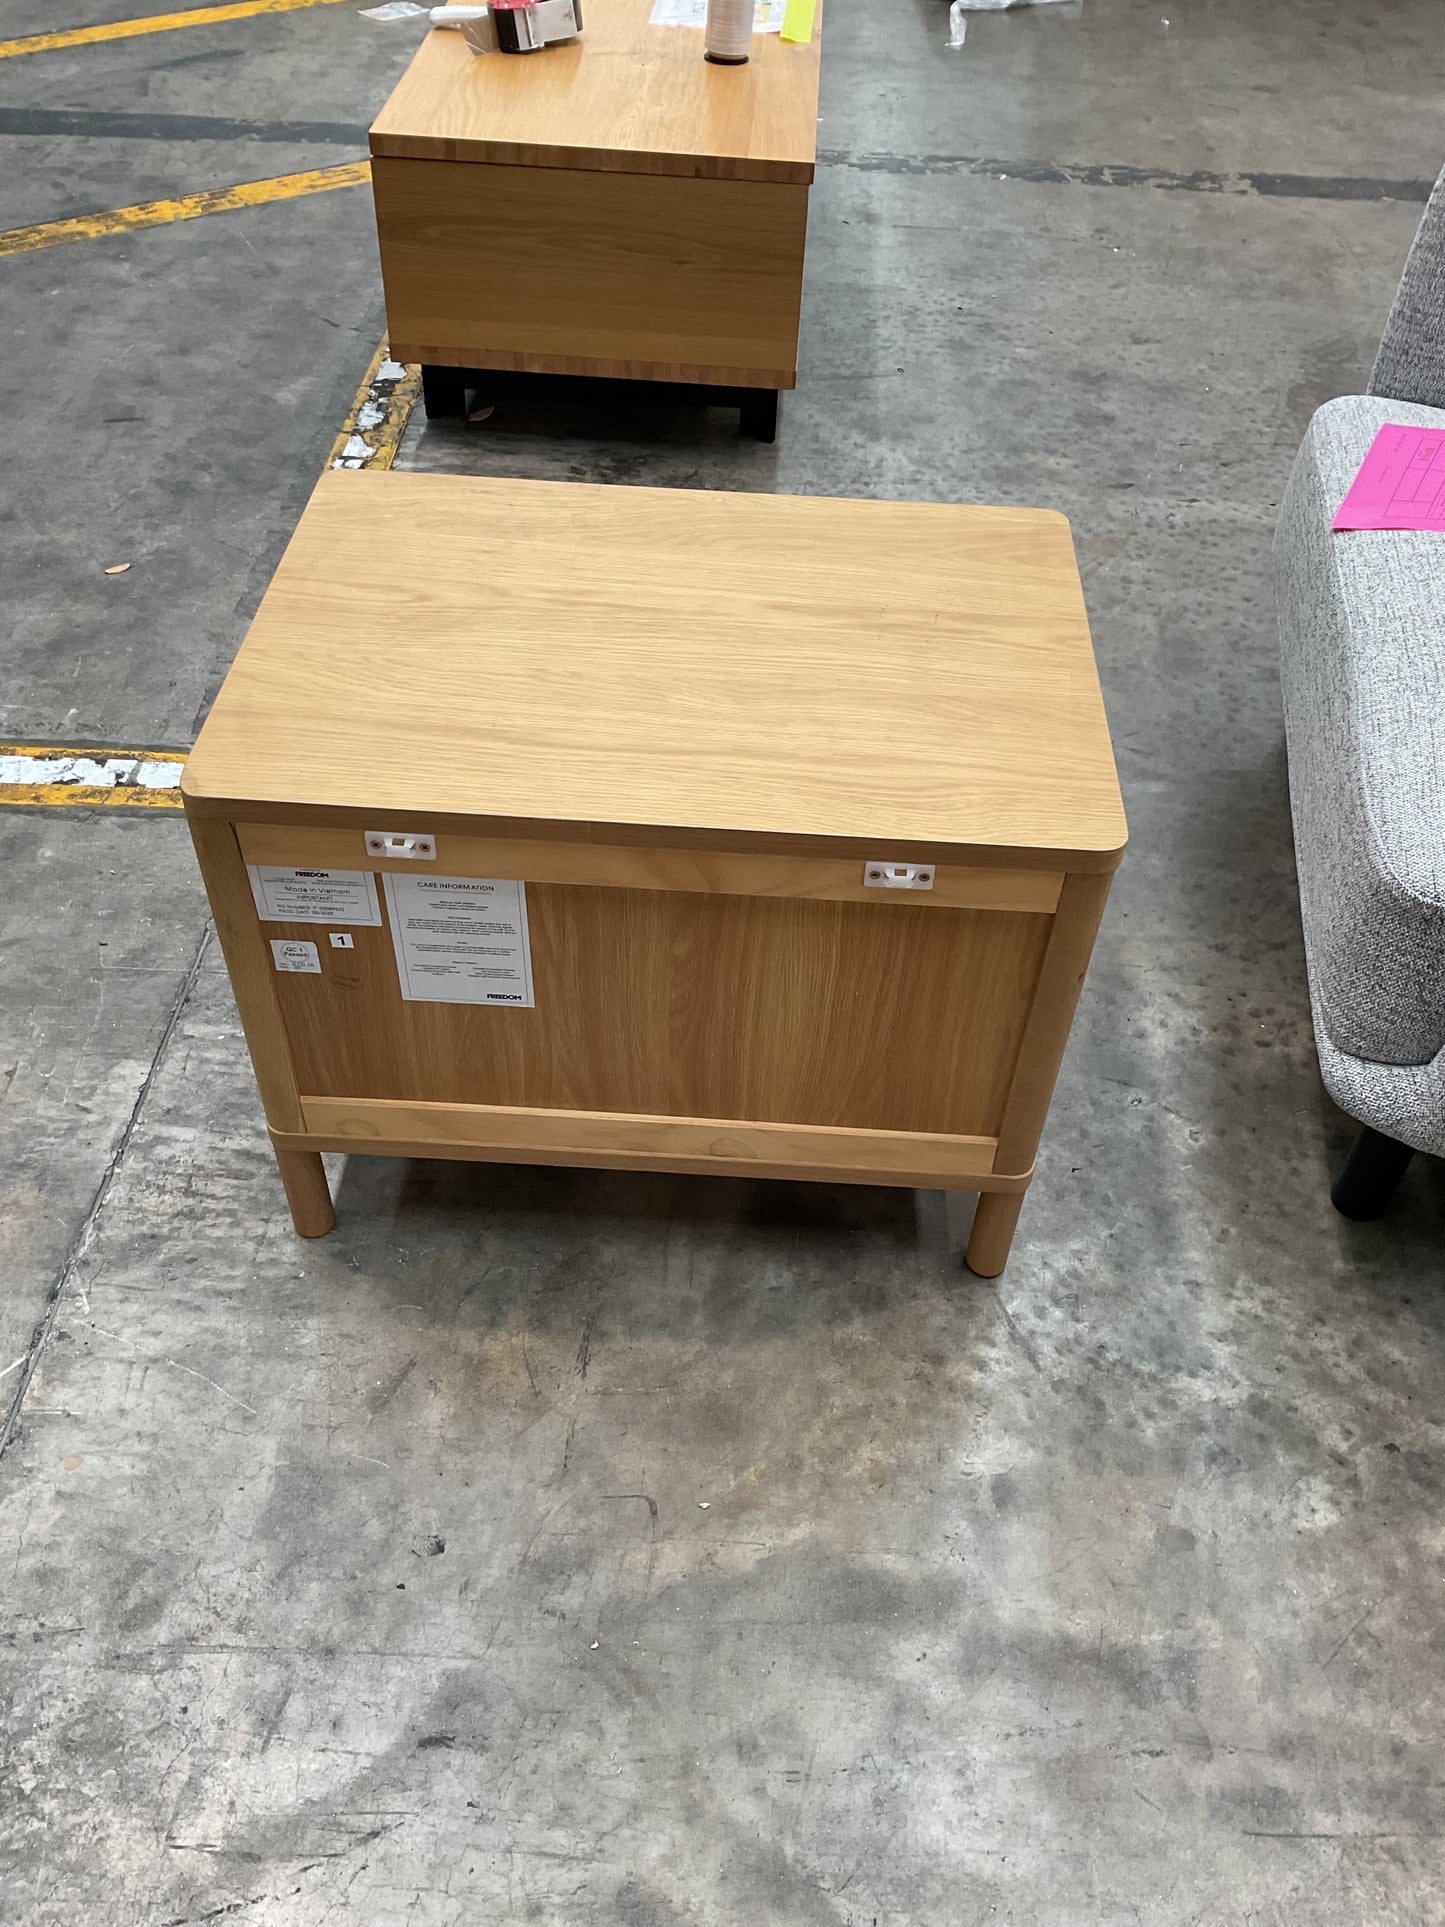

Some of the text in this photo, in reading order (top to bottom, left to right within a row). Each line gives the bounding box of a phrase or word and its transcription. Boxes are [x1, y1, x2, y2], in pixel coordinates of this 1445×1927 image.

[295, 871, 329, 879] FREEDOM
[417, 881, 495, 892] CARE INFORMATION
[318, 887, 351, 895] Vietnam
[337, 935, 346, 946] 1
[487, 993, 522, 1001] FREEDOM
